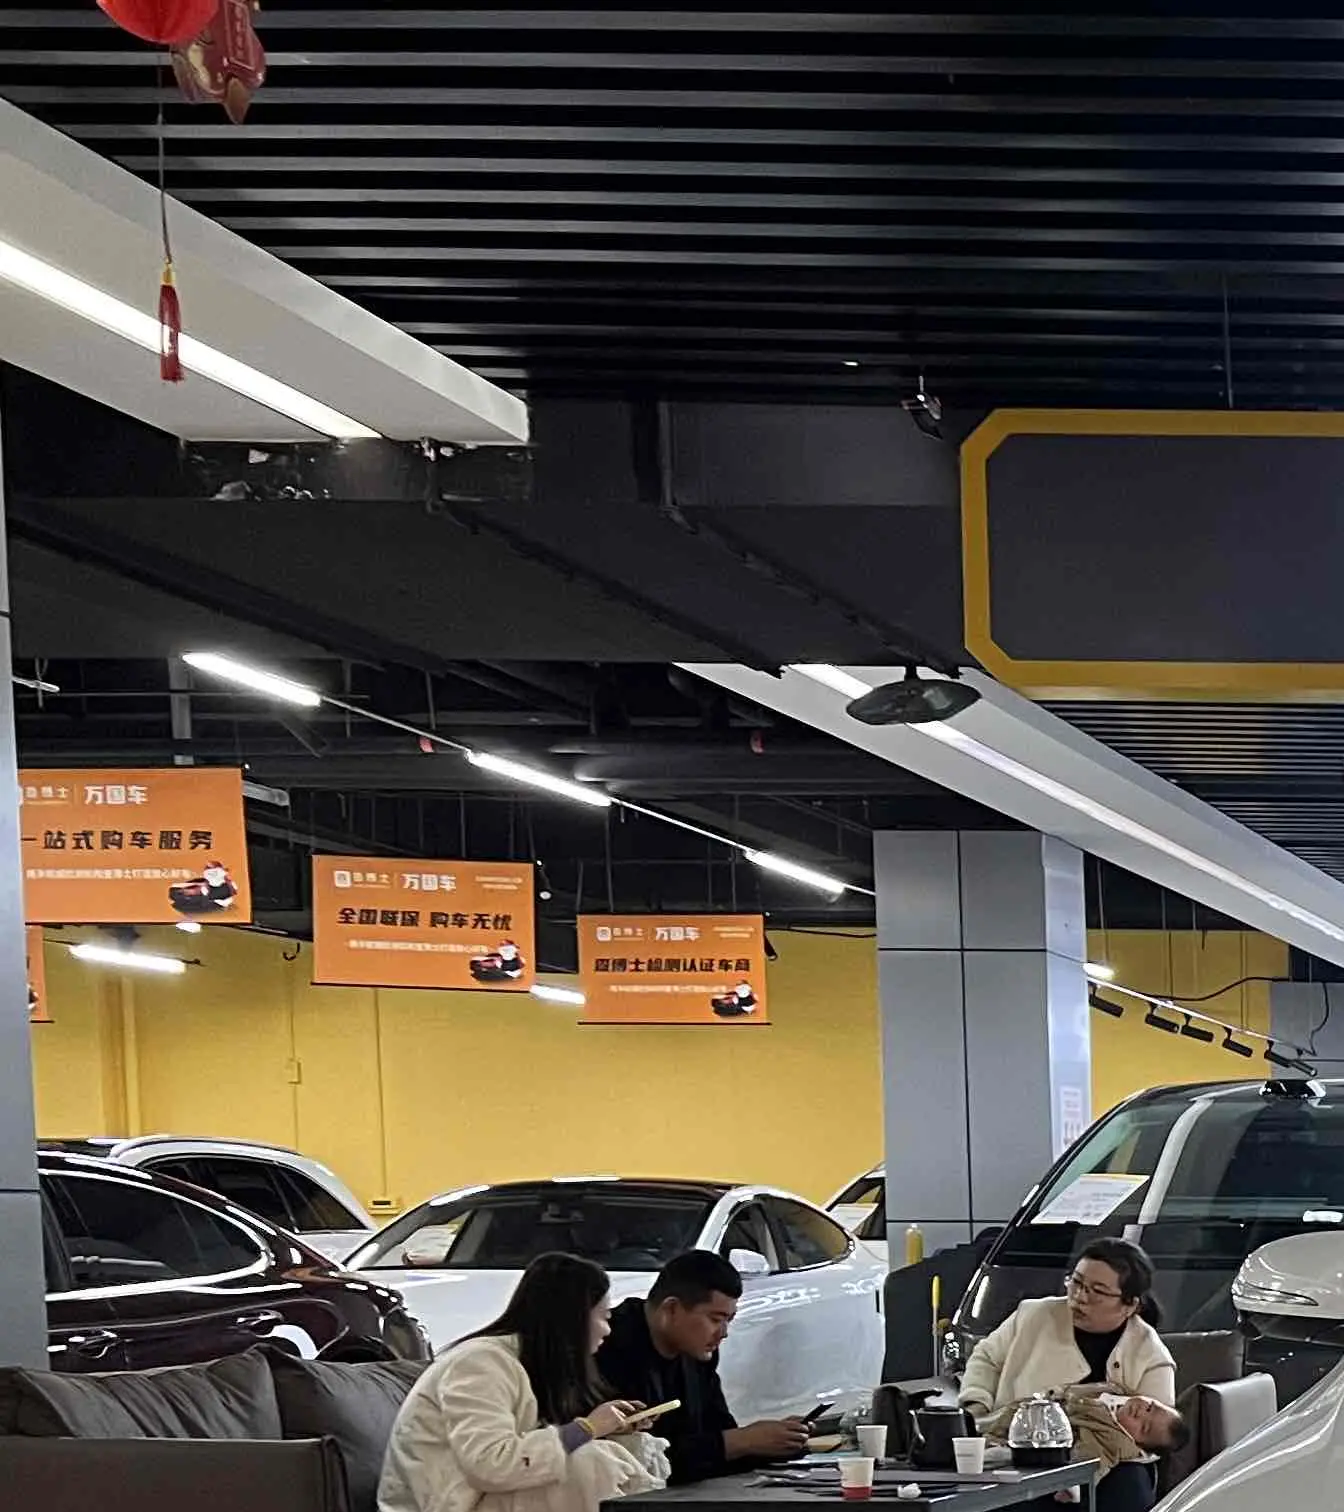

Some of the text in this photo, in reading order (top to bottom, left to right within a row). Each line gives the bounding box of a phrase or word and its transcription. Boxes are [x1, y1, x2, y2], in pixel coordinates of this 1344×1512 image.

[84, 784, 149, 804] 万国车
[21, 830, 213, 850] 一站式购车服务
[402, 873, 457, 891] 万国车
[337, 907, 513, 931] 全国联保 购车无忧
